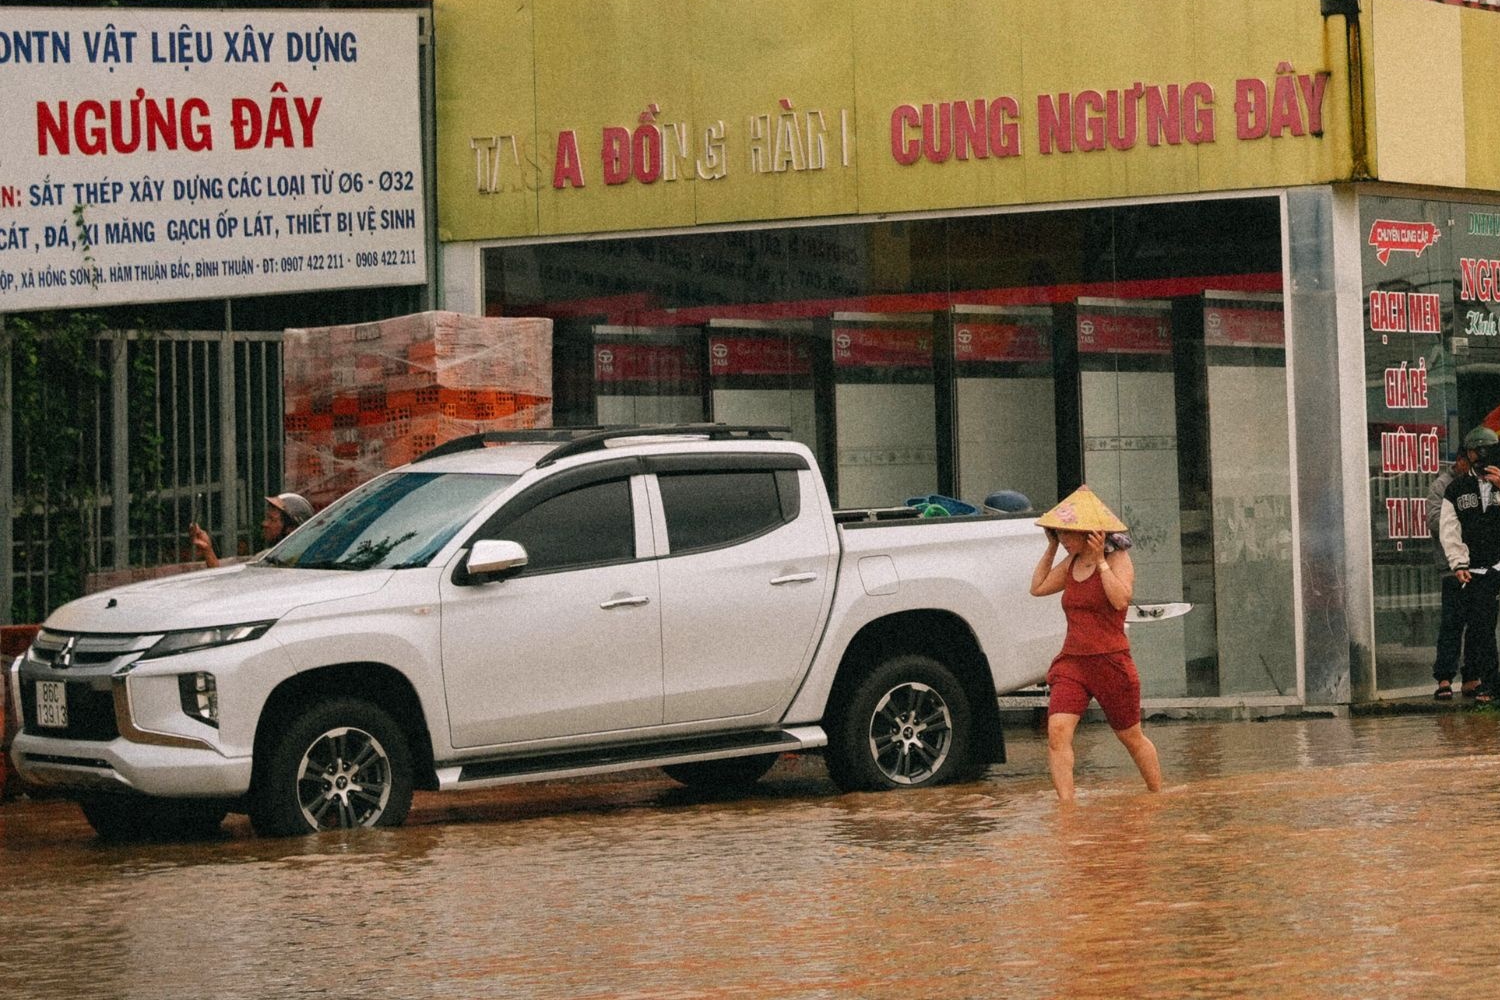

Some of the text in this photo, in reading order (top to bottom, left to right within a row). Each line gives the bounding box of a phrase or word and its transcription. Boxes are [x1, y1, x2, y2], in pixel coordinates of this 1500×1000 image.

[83, 24, 358, 72] VẬT LIỆU XÂY DỰNG
[36, 82, 323, 156] NGƯNG ĐÂY
[891, 61, 1331, 166] CUNG NGƯNG ĐÂY
[29, 175, 65, 206] SẮT
[73, 176, 124, 204] THÉP
[130, 176, 165, 202] XÂY
[173, 175, 223, 205] DỰNG
[228, 172, 262, 198] CÁC
[267, 176, 305, 200] LOẠI
[311, 168, 334, 194] TỪ
[45, 220, 76, 250] ĐÁ,
[82, 224, 99, 245] XI
[105, 217, 155, 245] MĂNG
[167, 218, 210, 245] GẠCH
[216, 209, 238, 238] ỐP
[244, 211, 279, 238] LÁT,
[286, 205, 331, 234] THIẾT
[337, 212, 353, 237] BỊ
[357, 206, 376, 235] VỆ
[380, 209, 415, 229] SINH
[21, 250, 415, 288] XÃ HỒNG HÀM THUẬN BẮC, BÌNH THUẬN ĐT: 0907 422 211 0908 422 211
[1370, 291, 1441, 344] GẠCH MEN
[1385, 357, 1428, 408] GIÁ RẺ
[1382, 426, 1439, 473] LUÔN CÓ
[1386, 498, 1408, 551] TẠI
[43, 683, 59, 702] 86C
